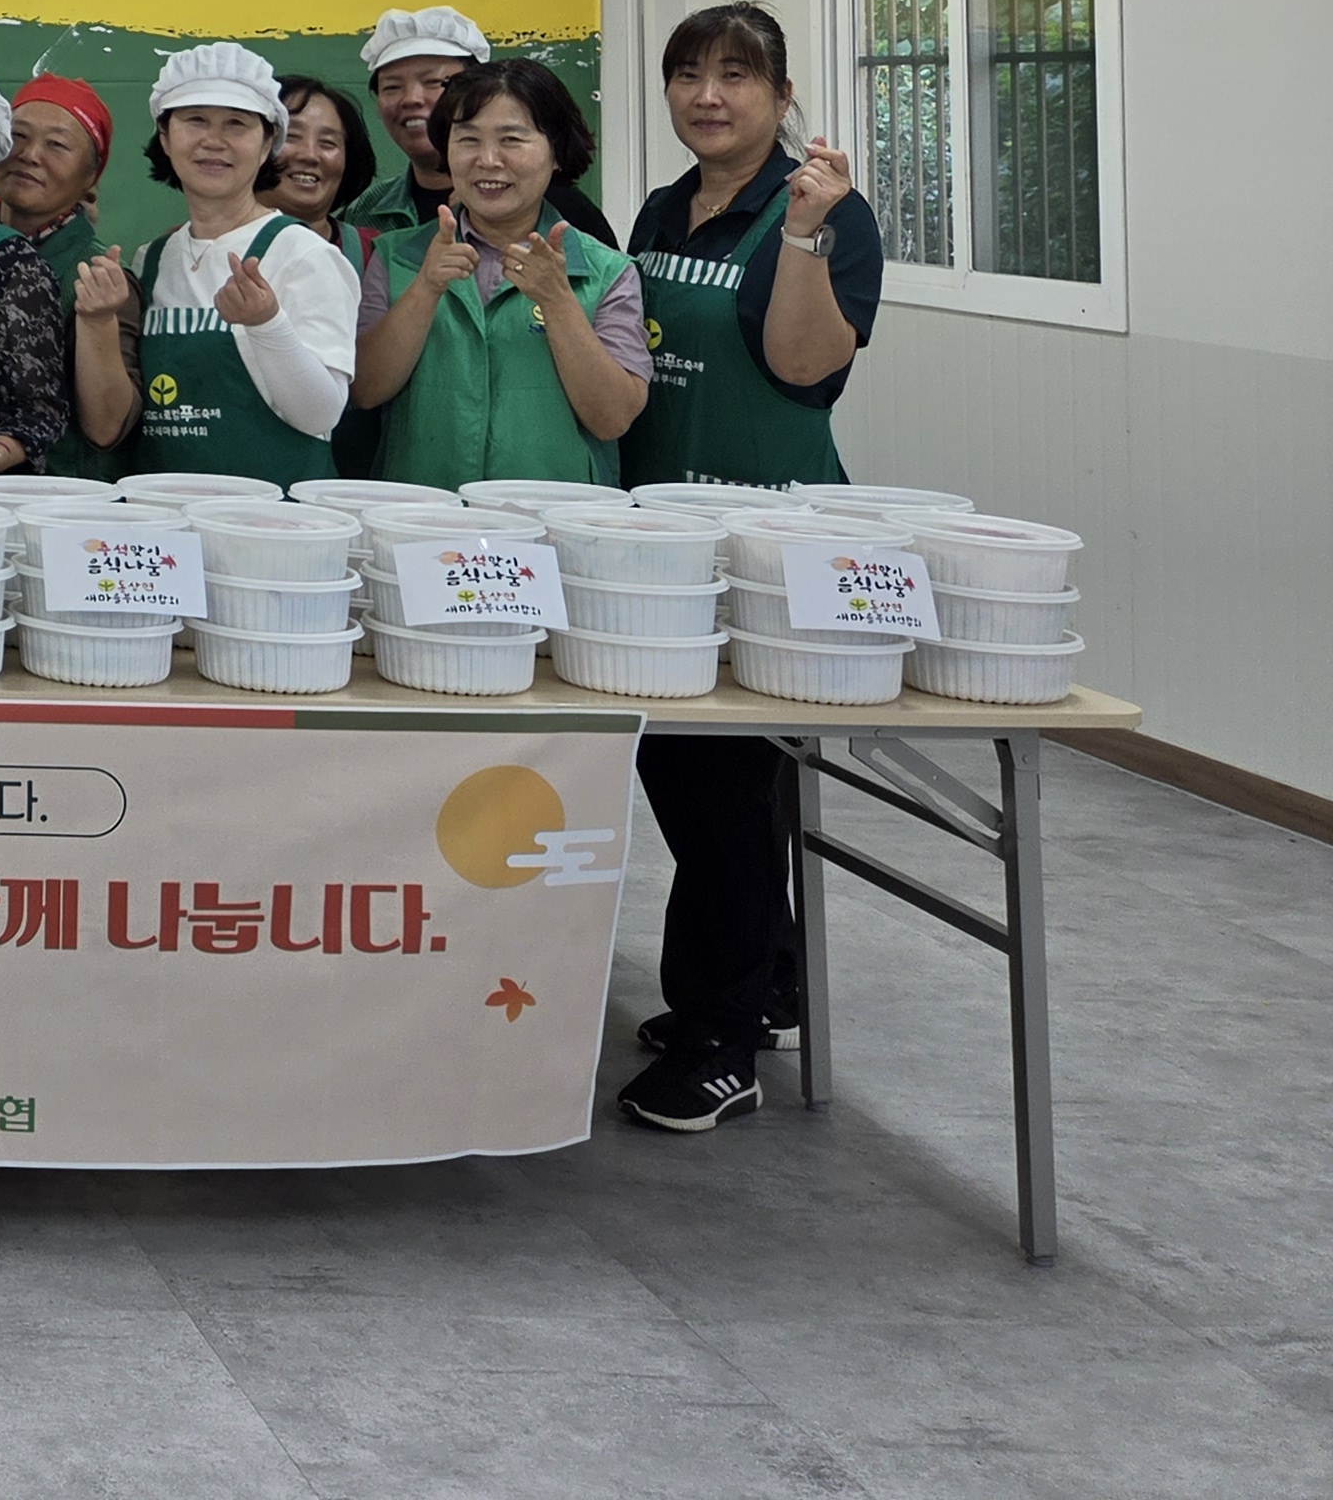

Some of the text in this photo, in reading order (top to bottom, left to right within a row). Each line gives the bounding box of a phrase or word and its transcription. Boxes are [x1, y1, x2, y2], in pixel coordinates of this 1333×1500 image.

[97, 541, 161, 557] 추석맞이
[87, 556, 161, 577] 음식나눔
[454, 552, 519, 568] 추석맞이
[846, 559, 903, 578] 추석맞이
[445, 567, 521, 587] 음식나눔
[837, 575, 906, 598] 음식나눔
[106, 880, 447, 955] 나눕니다.
